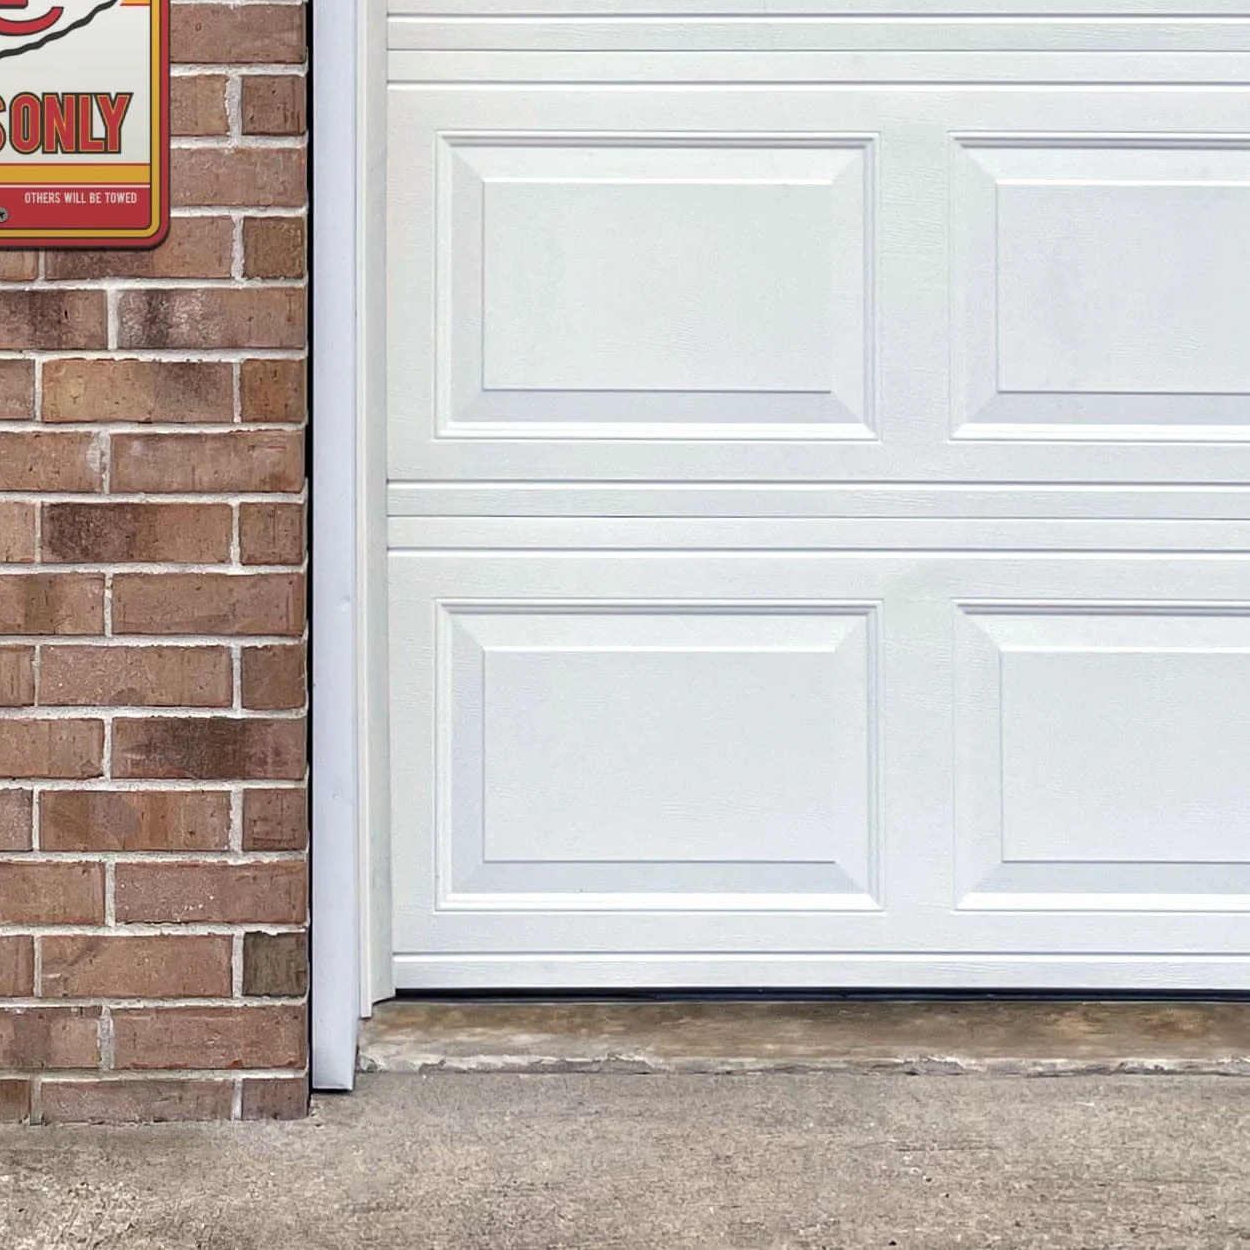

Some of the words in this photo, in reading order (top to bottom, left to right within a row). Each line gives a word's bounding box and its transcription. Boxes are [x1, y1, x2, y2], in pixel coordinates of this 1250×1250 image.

[8, 91, 135, 156] ONLY
[24, 192, 61, 204] OTHERS
[64, 192, 86, 204] WILL
[89, 192, 102, 204] BE
[105, 192, 137, 204] TOWED
